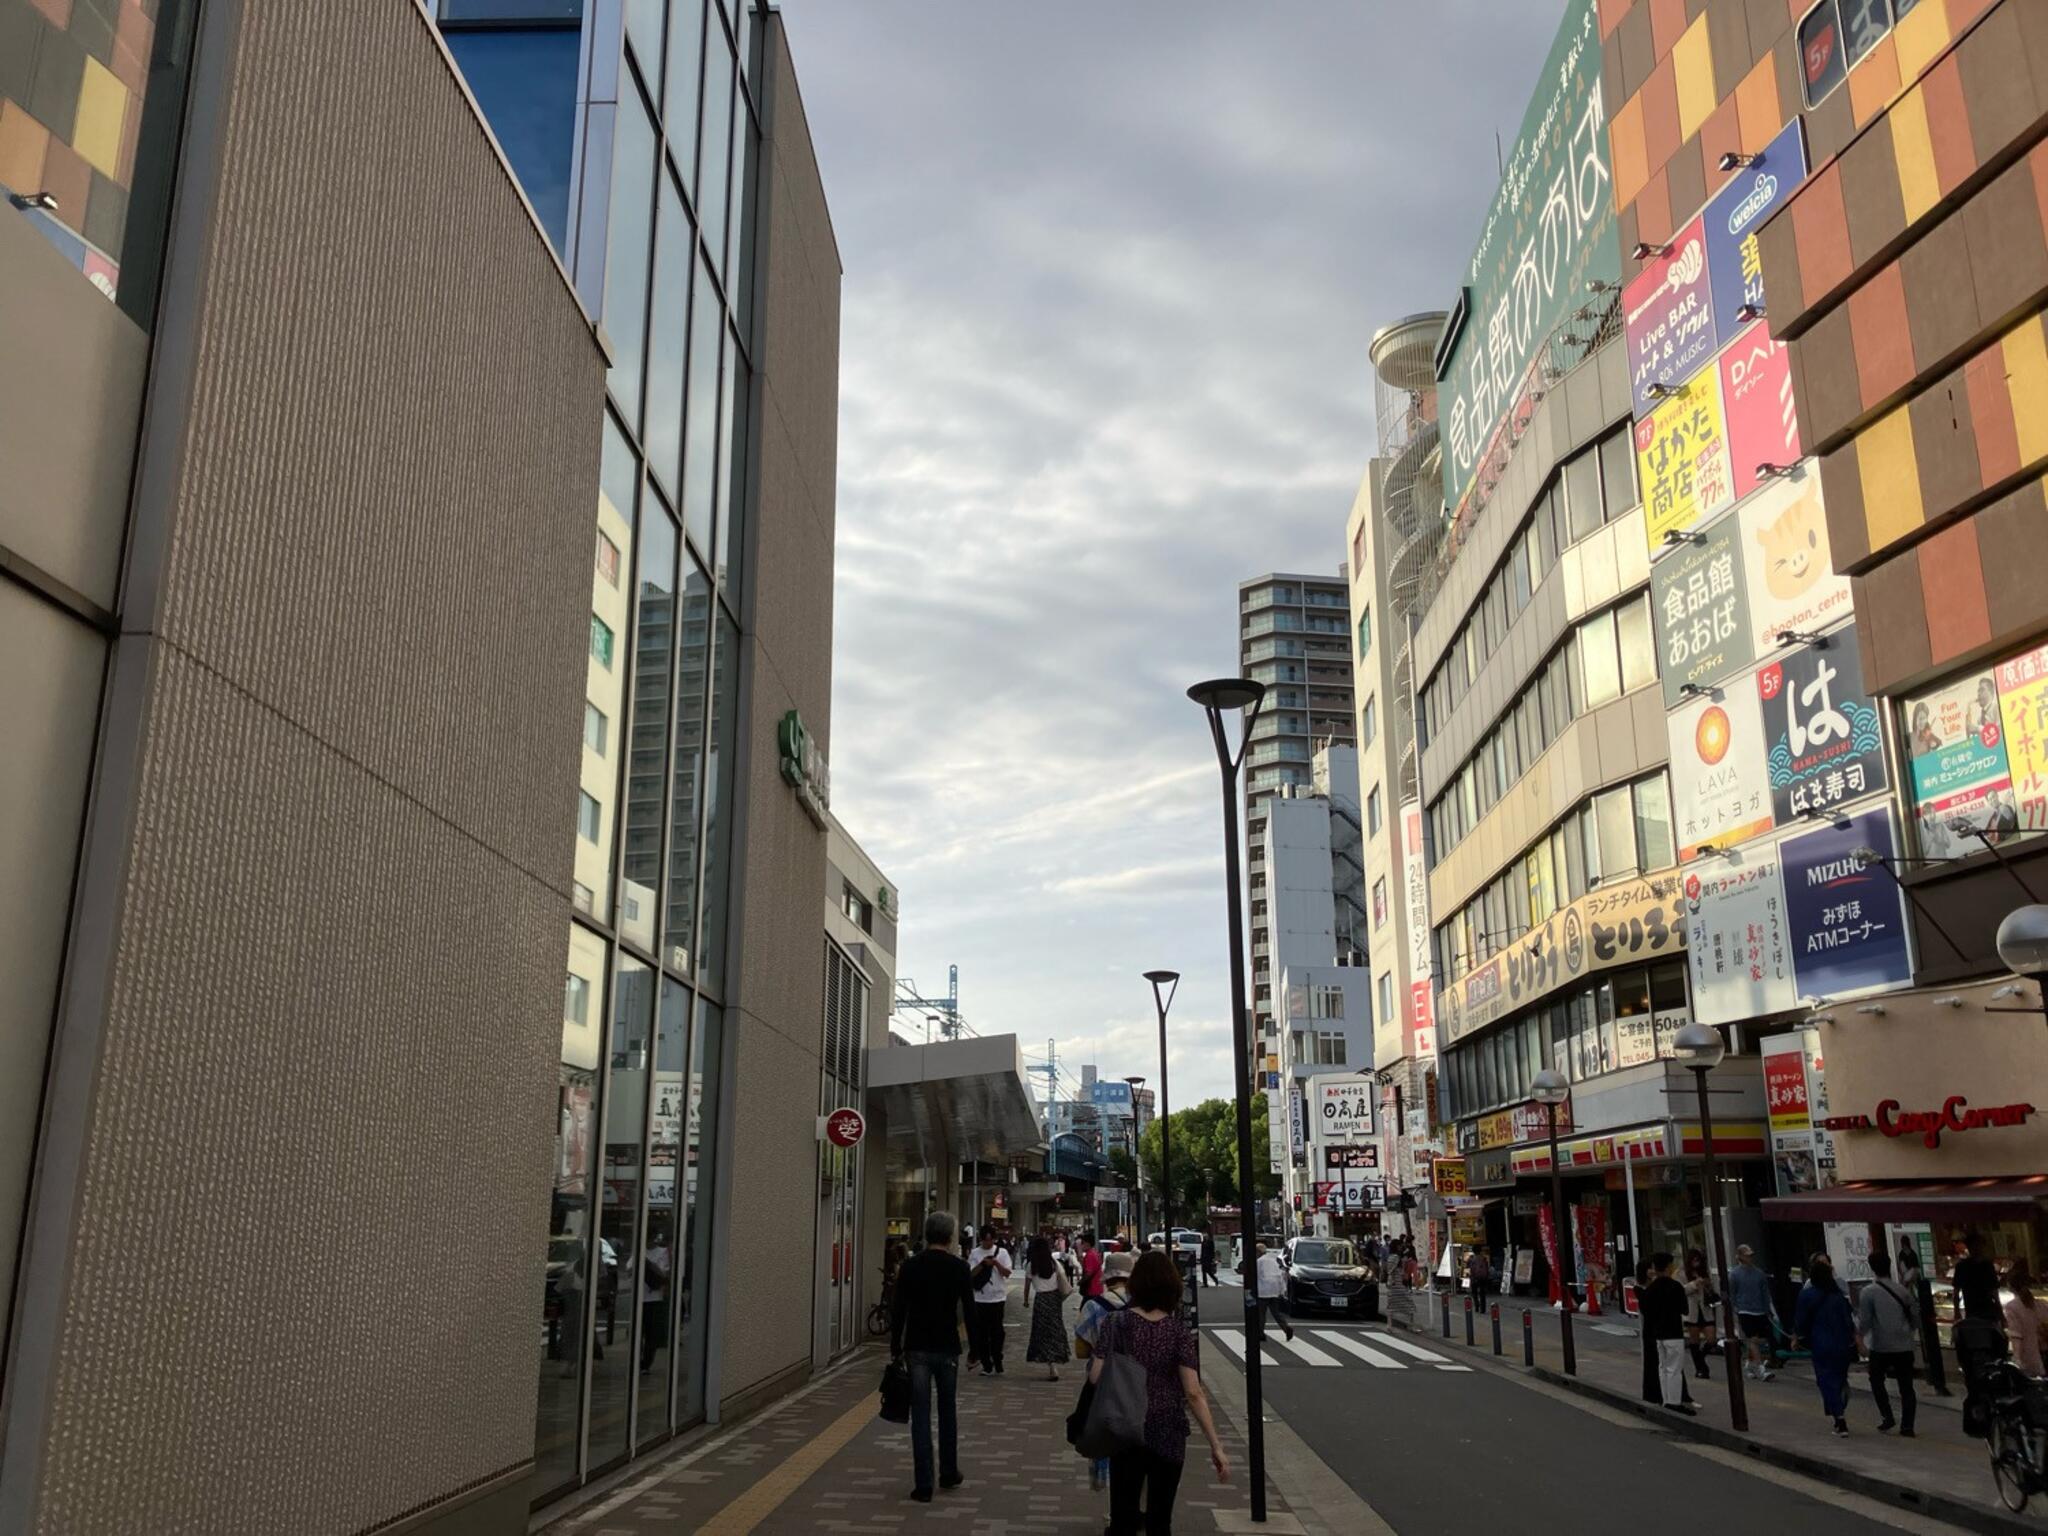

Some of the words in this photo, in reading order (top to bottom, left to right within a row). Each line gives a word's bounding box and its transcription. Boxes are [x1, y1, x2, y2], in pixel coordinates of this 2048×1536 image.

[1733, 184, 1773, 229] welcia
[1449, 75, 1609, 494] 食品館あおば
[1640, 322, 1666, 356] Live
[1668, 292, 1698, 328] BAR
[1675, 335, 1706, 372] MUSIC
[1734, 372, 1765, 400] ダイソー
[1652, 458, 1693, 520] 商店
[1662, 551, 1735, 629] 食品館
[1668, 595, 1737, 668] あおば
[1763, 671, 1779, 694] 5F
[1787, 657, 1850, 757] は
[2010, 694, 2044, 794] ハイボール
[1697, 766, 1738, 796] LAVA
[1790, 763, 1866, 815] はま寿司
[1940, 755, 1998, 784] ミュージックサロン
[1685, 790, 1760, 836] ホットヨガ
[1408, 860, 1429, 972] 24時間ジム
[1807, 919, 1885, 953] ATMコーナー
[1822, 900, 1862, 926] みずほ
[1333, 1121, 1361, 1131] RAMEN
